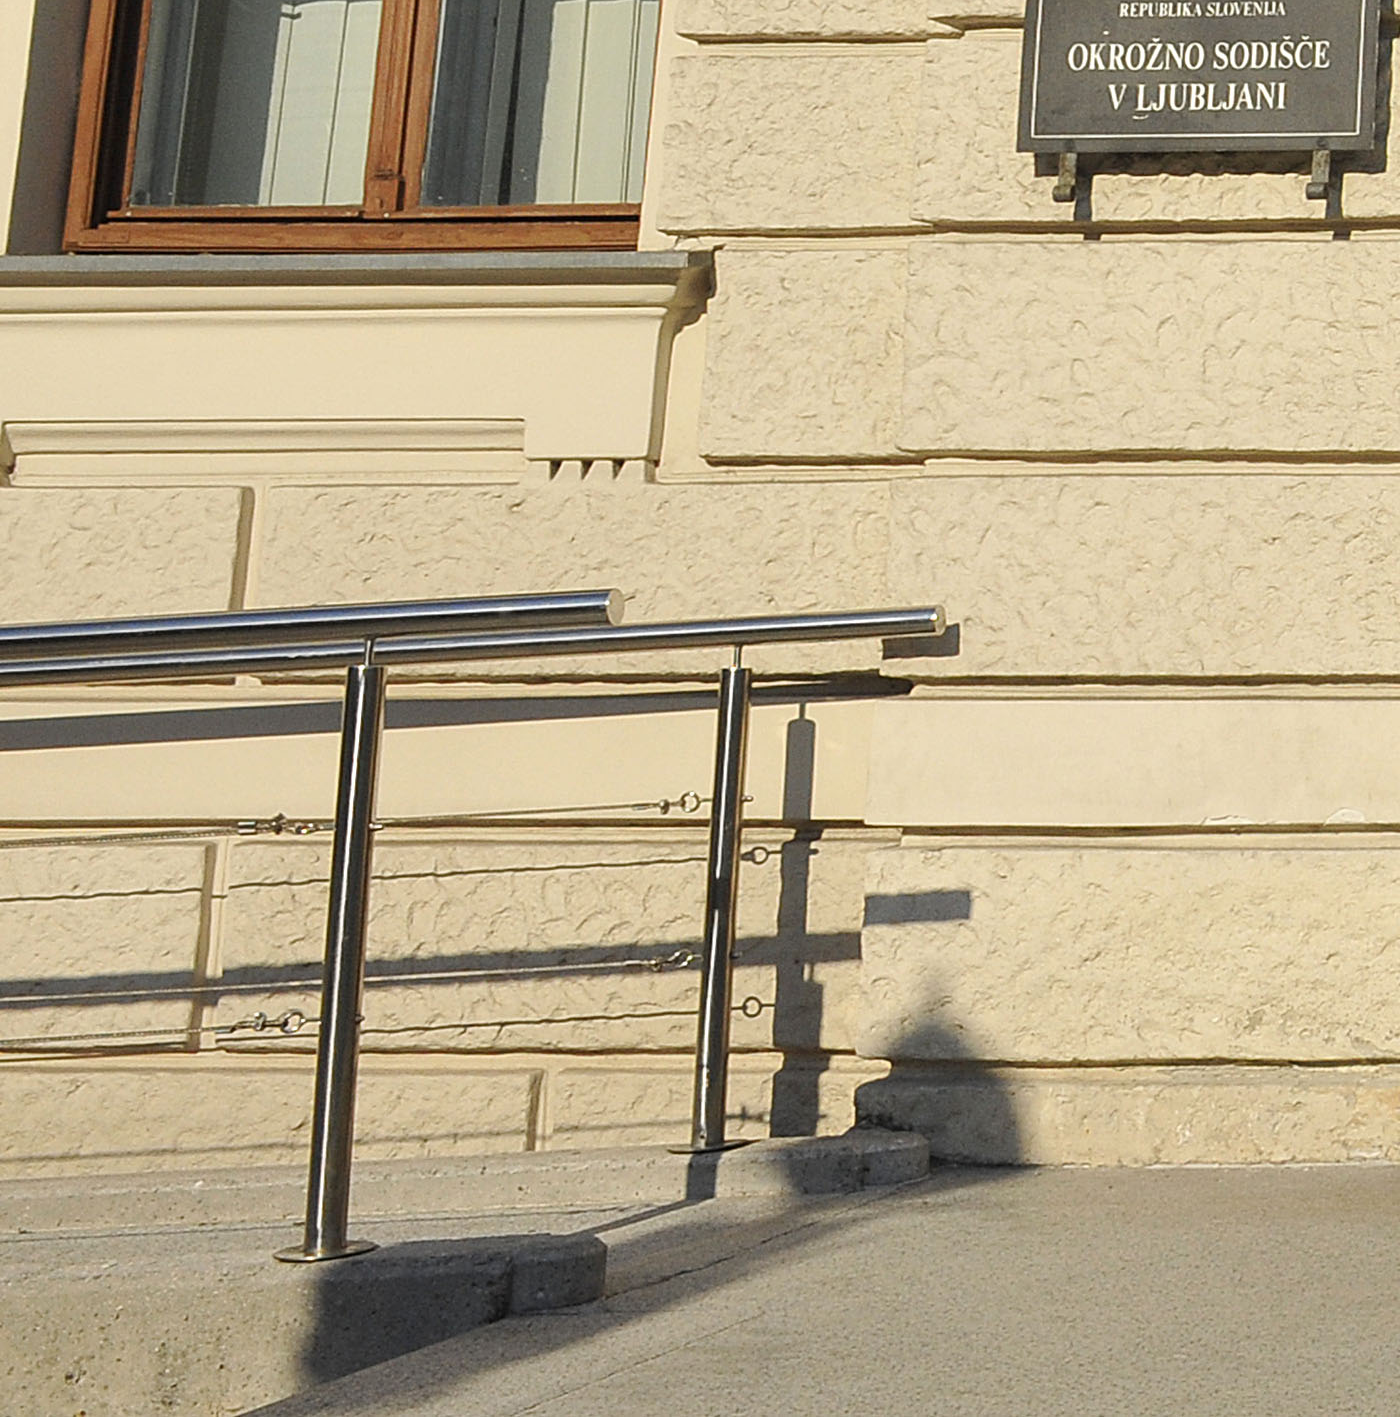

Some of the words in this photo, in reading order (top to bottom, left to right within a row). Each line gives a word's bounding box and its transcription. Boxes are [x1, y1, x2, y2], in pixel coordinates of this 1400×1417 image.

[1120, 3, 1201, 17] REPUBLIKA
[1206, 2, 1285, 16] SLOVENIJA
[1068, 38, 1204, 70] OKROŽNO
[1213, 36, 1329, 70] SODIŠČE
[1109, 84, 1126, 109] V
[1136, 82, 1286, 111] LJUBLJANI
